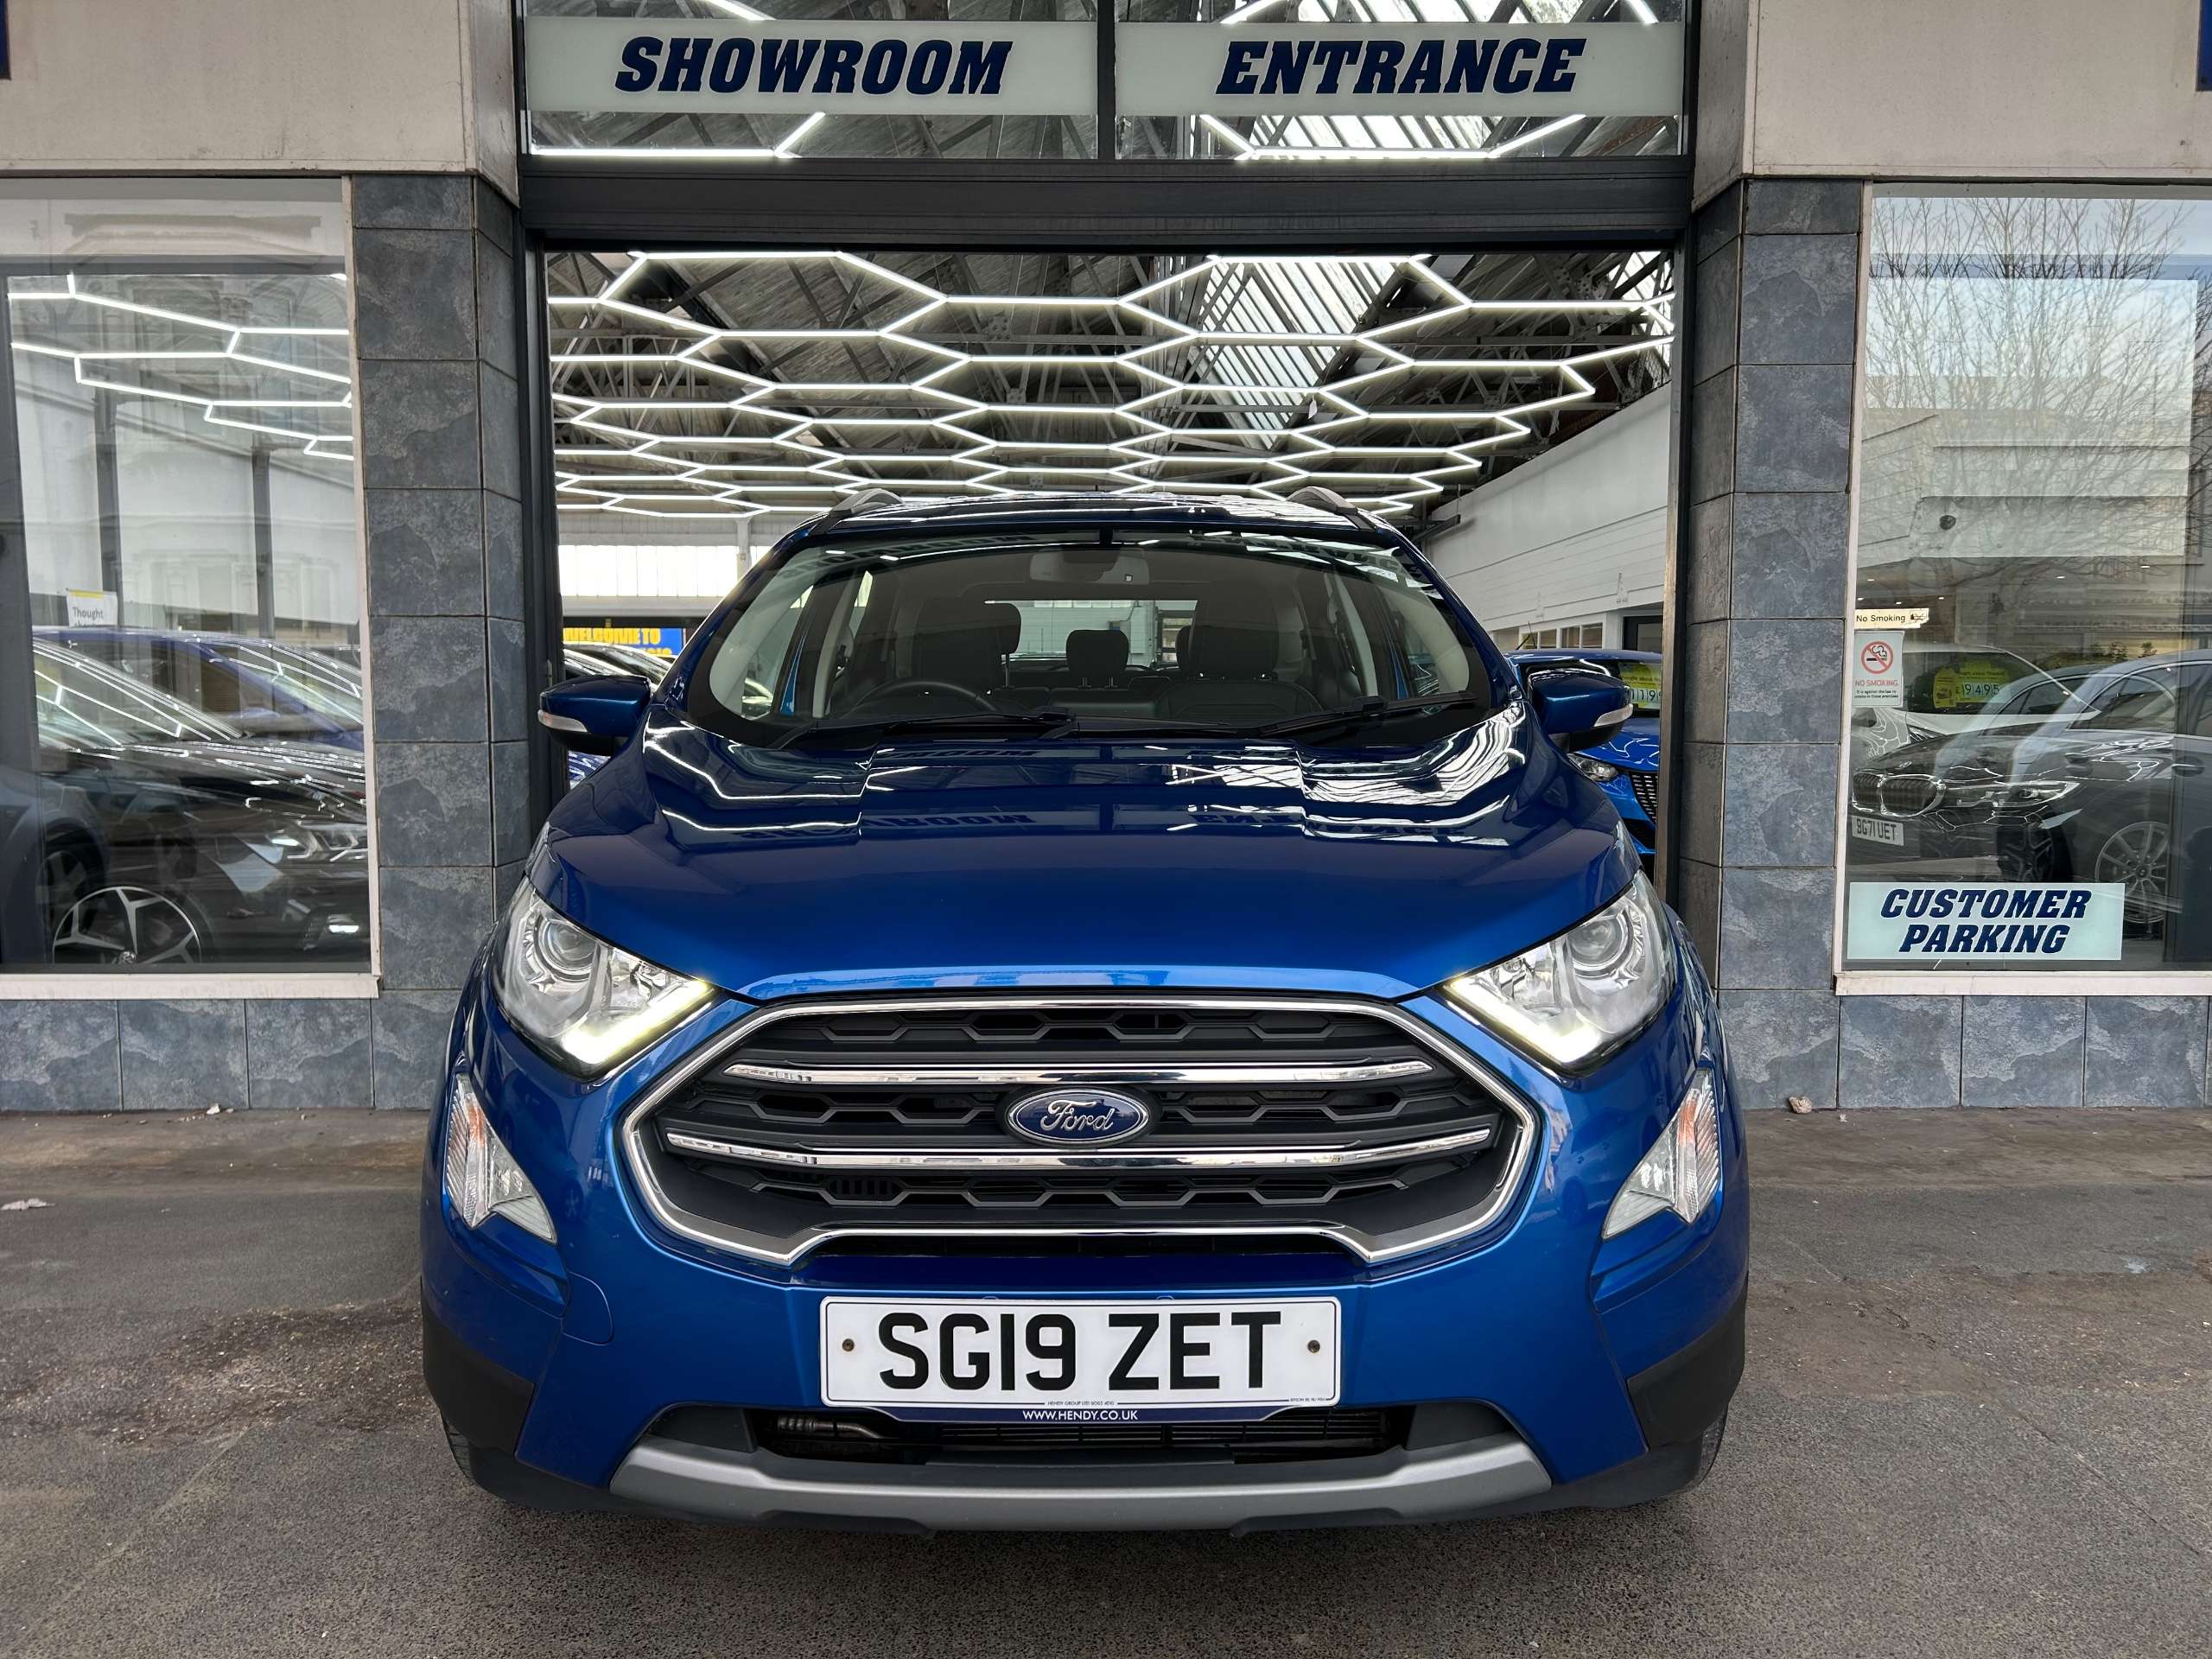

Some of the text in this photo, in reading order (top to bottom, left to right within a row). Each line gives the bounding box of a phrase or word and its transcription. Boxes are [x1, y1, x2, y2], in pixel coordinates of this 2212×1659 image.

[615, 36, 1014, 96] SHOWROOM
[1215, 37, 1588, 95] ENTRANCE
[72, 607, 105, 620] Thought
[1871, 614, 1906, 623] Smoking
[641, 628, 661, 645] TO
[1857, 818, 1897, 842] BG71 UET
[1880, 888, 2093, 918] CUSTOMER
[1898, 924, 2071, 954] PARKING
[1040, 1099, 1116, 1132] Ford
[878, 1311, 1281, 1391] SG19 ZET
[1022, 1409, 1139, 1421] WWW.HENDY.CO.UK
